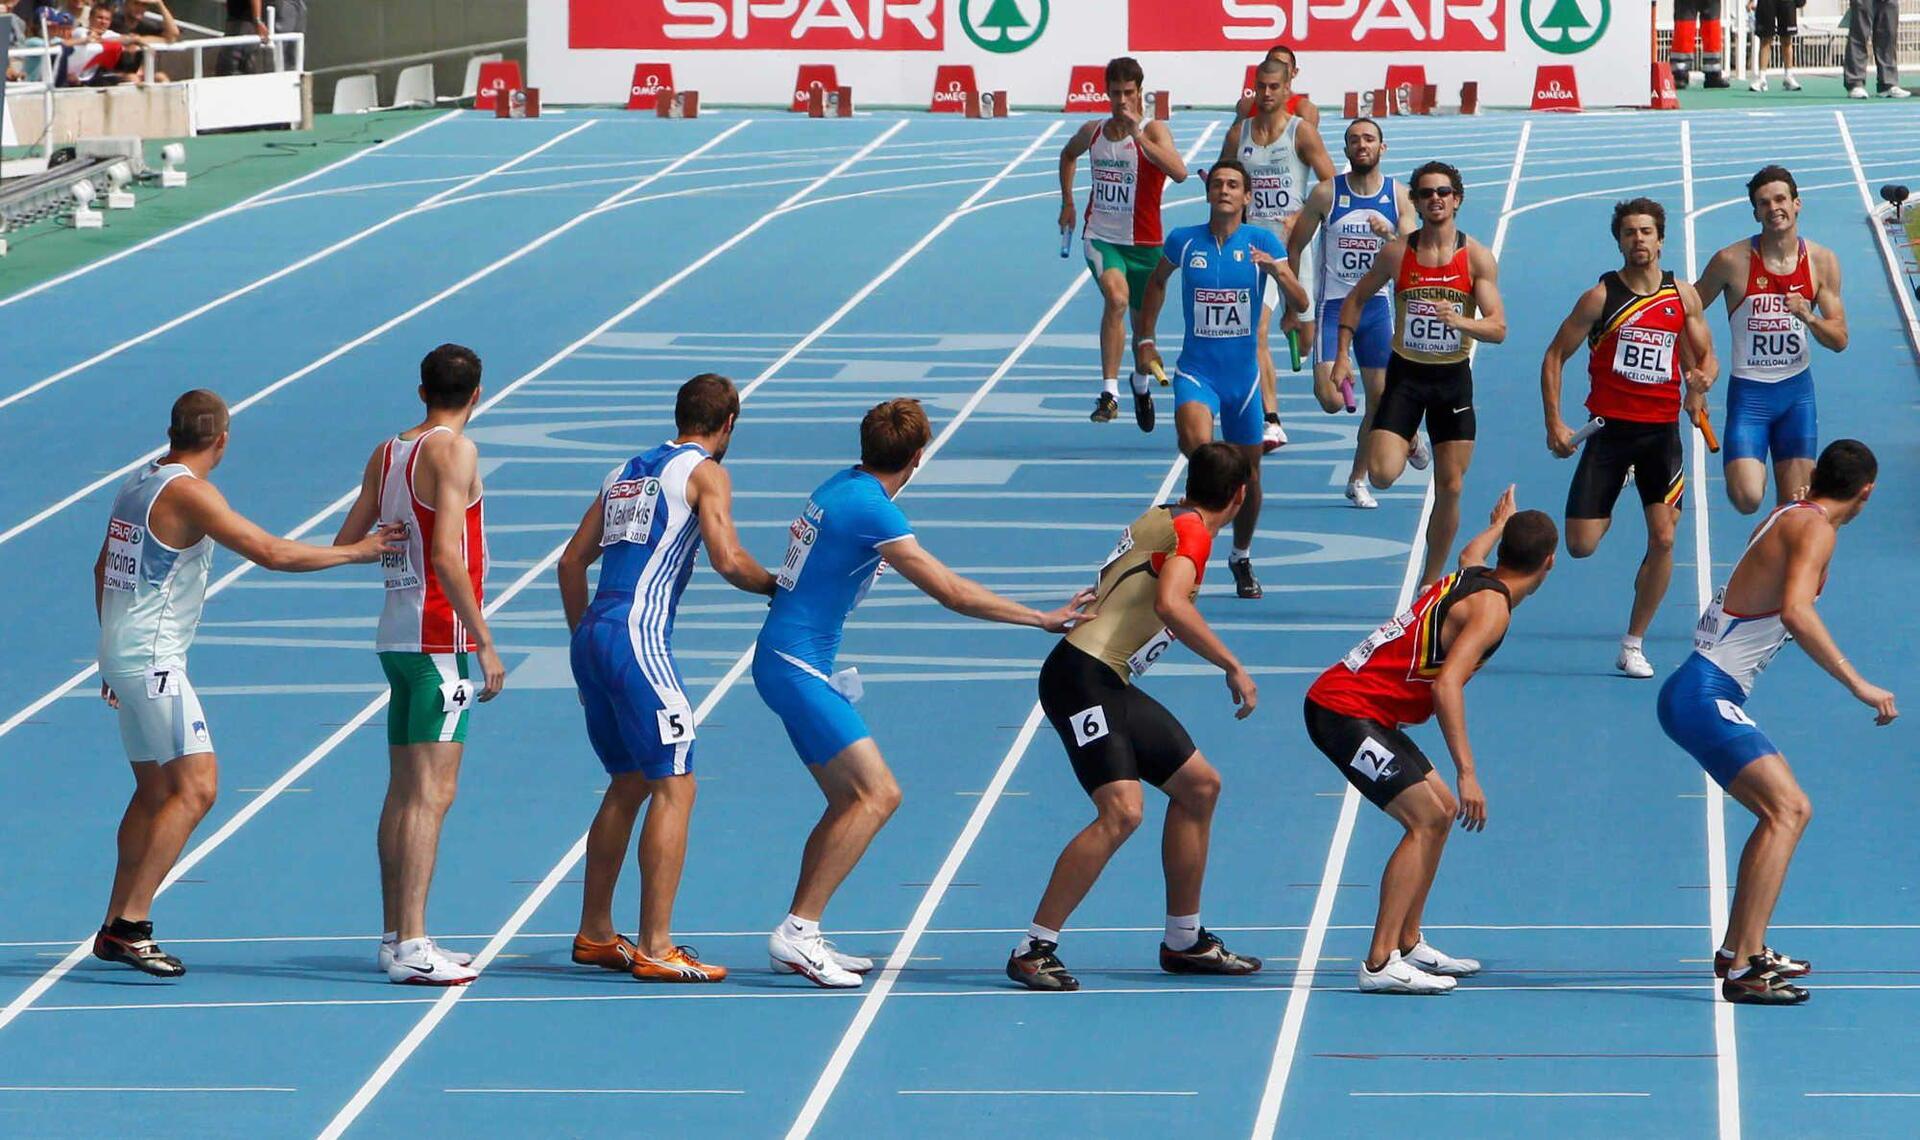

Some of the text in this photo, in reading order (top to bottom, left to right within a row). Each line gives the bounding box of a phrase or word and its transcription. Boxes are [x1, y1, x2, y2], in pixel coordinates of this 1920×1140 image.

[662, 0, 938, 39] SPAR
[1222, 0, 1498, 41] SPAR
[1537, 89, 1574, 99] OMEGA
[1096, 182, 1130, 204] HUN
[1254, 190, 1290, 209] SLO
[1339, 239, 1377, 249] SPAR
[1196, 291, 1237, 302] SPAR
[1205, 306, 1241, 326] ITA
[1408, 303, 1437, 316] SPA
[1196, 328, 1235, 337] BARCELONA
[1410, 318, 1456, 340] GER
[1748, 320, 1790, 331] SPAR
[1405, 341, 1444, 351] BARCELONA
[1621, 330, 1664, 345] SPAR
[1753, 334, 1801, 355] RUS
[1623, 345, 1666, 372] BEL
[608, 483, 644, 498] SPAR
[630, 530, 647, 541] 2010
[153, 671, 170, 693] 7
[453, 685, 467, 706] 4
[669, 713, 684, 738] 5
[1083, 713, 1100, 737] 6
[1360, 750, 1386, 771] 2
